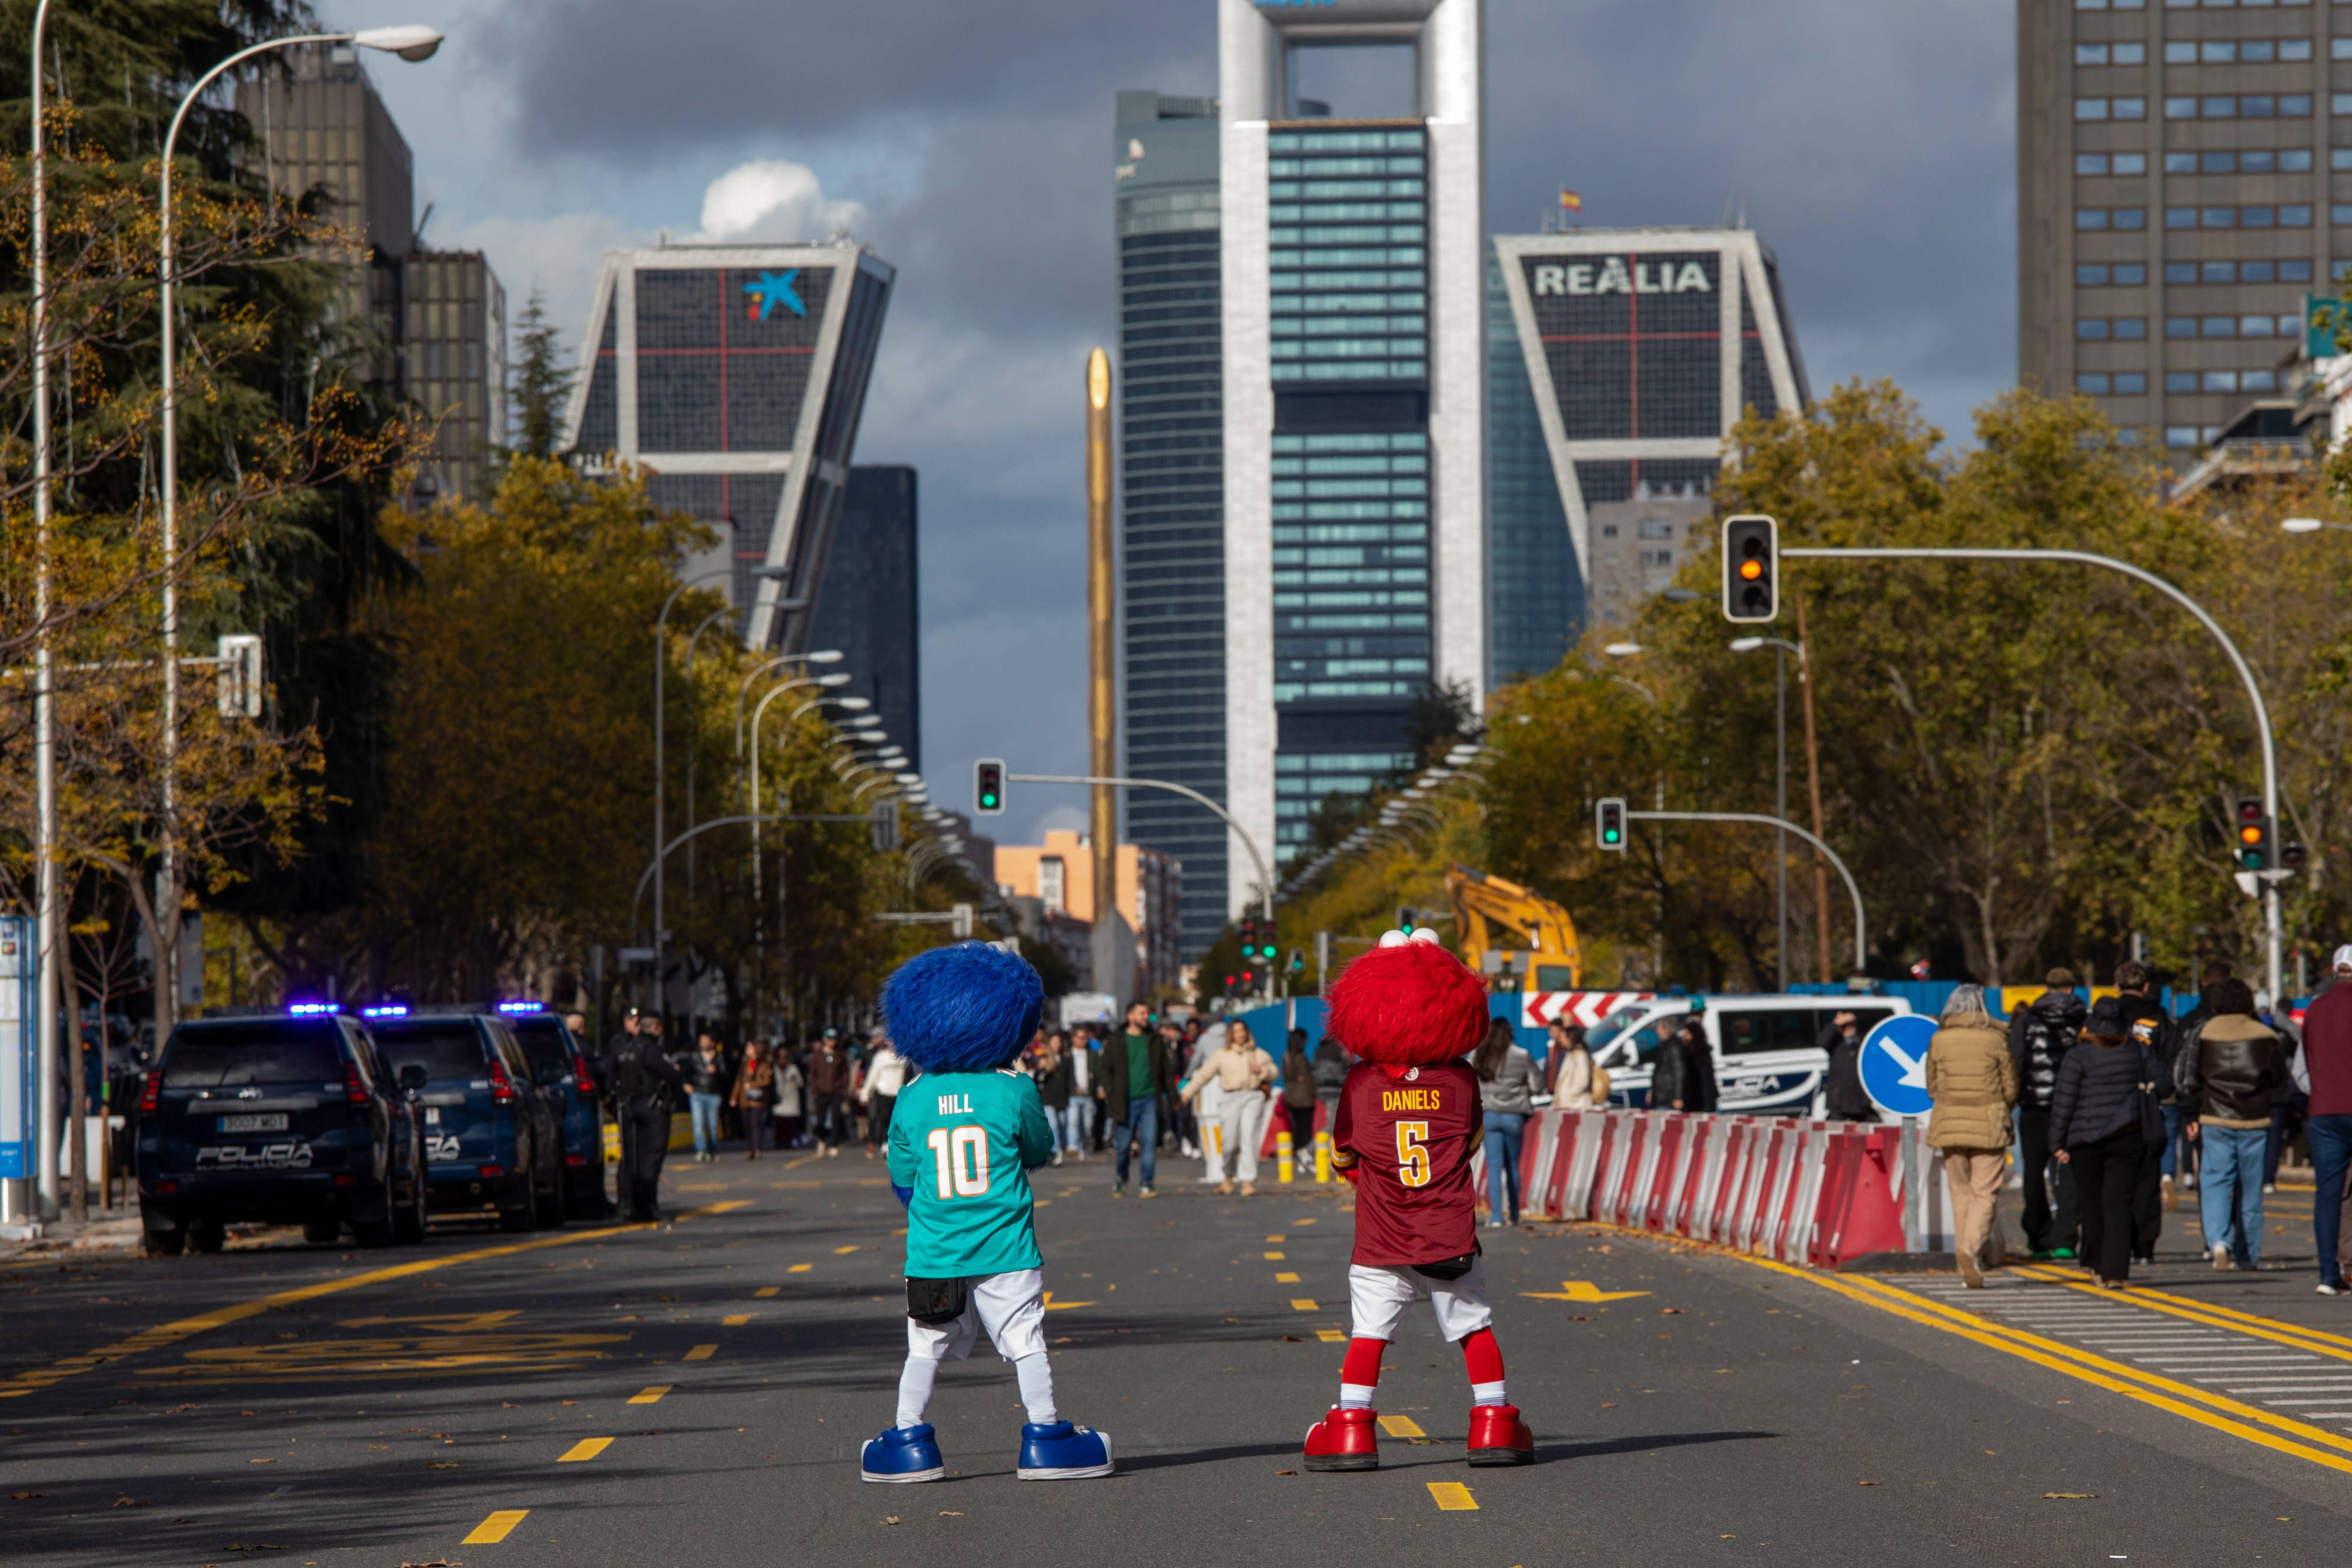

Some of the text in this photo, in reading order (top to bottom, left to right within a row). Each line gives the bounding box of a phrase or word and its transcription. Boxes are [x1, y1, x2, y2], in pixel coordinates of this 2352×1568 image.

[938, 1094, 974, 1115] HILL
[1383, 1089, 1440, 1111] DANIELS
[927, 1125, 989, 1199] 10
[1396, 1121, 1431, 1186] 5
